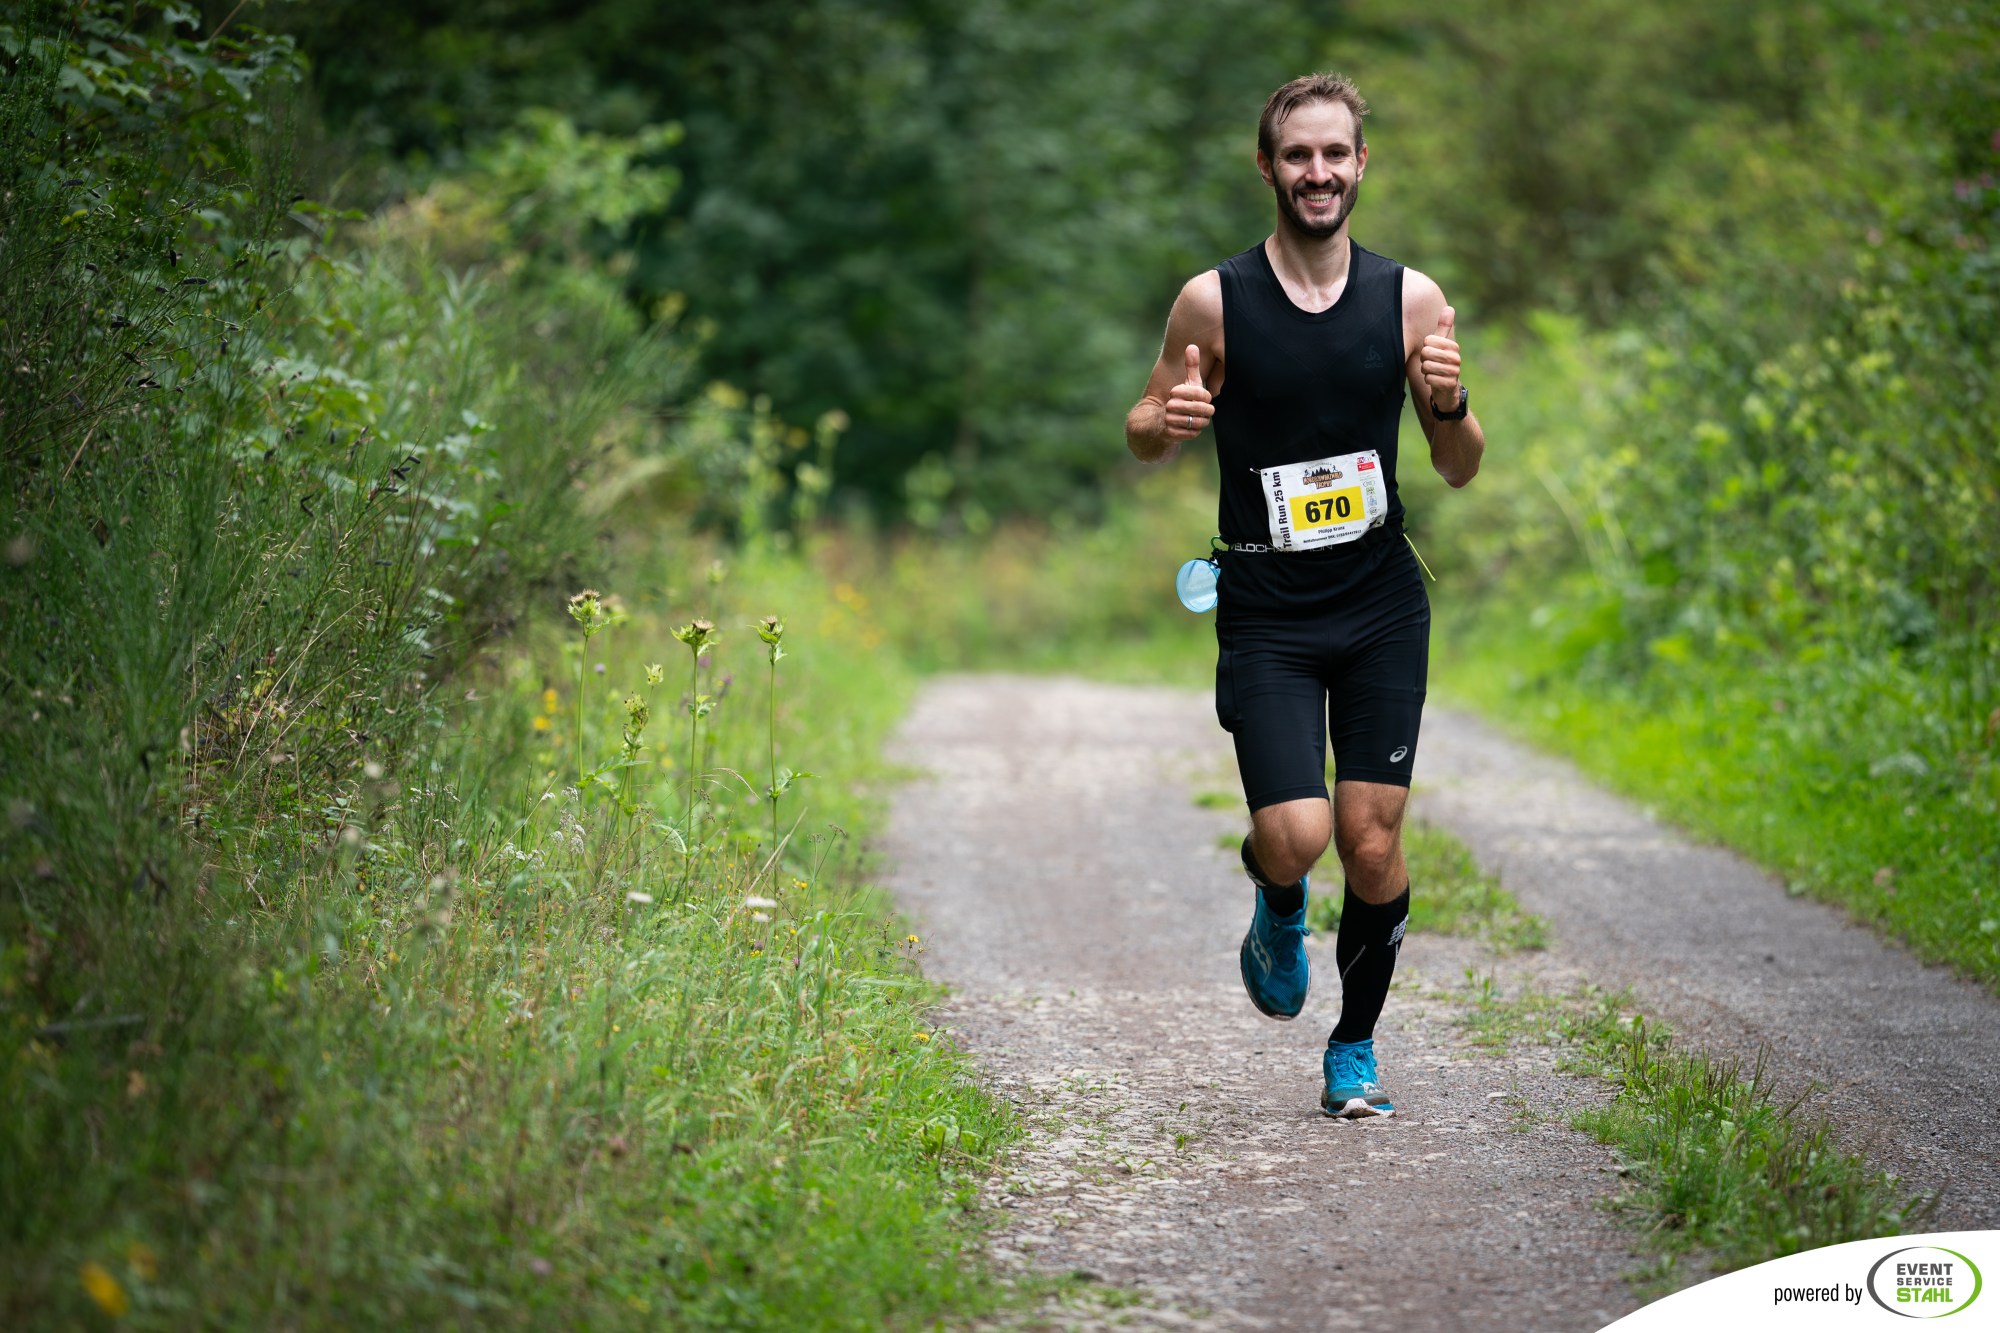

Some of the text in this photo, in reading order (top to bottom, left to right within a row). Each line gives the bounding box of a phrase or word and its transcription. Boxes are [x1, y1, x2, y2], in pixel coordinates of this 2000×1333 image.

[1272, 472, 1292, 548] Trail Run 25 km
[1305, 496, 1350, 523] 670
